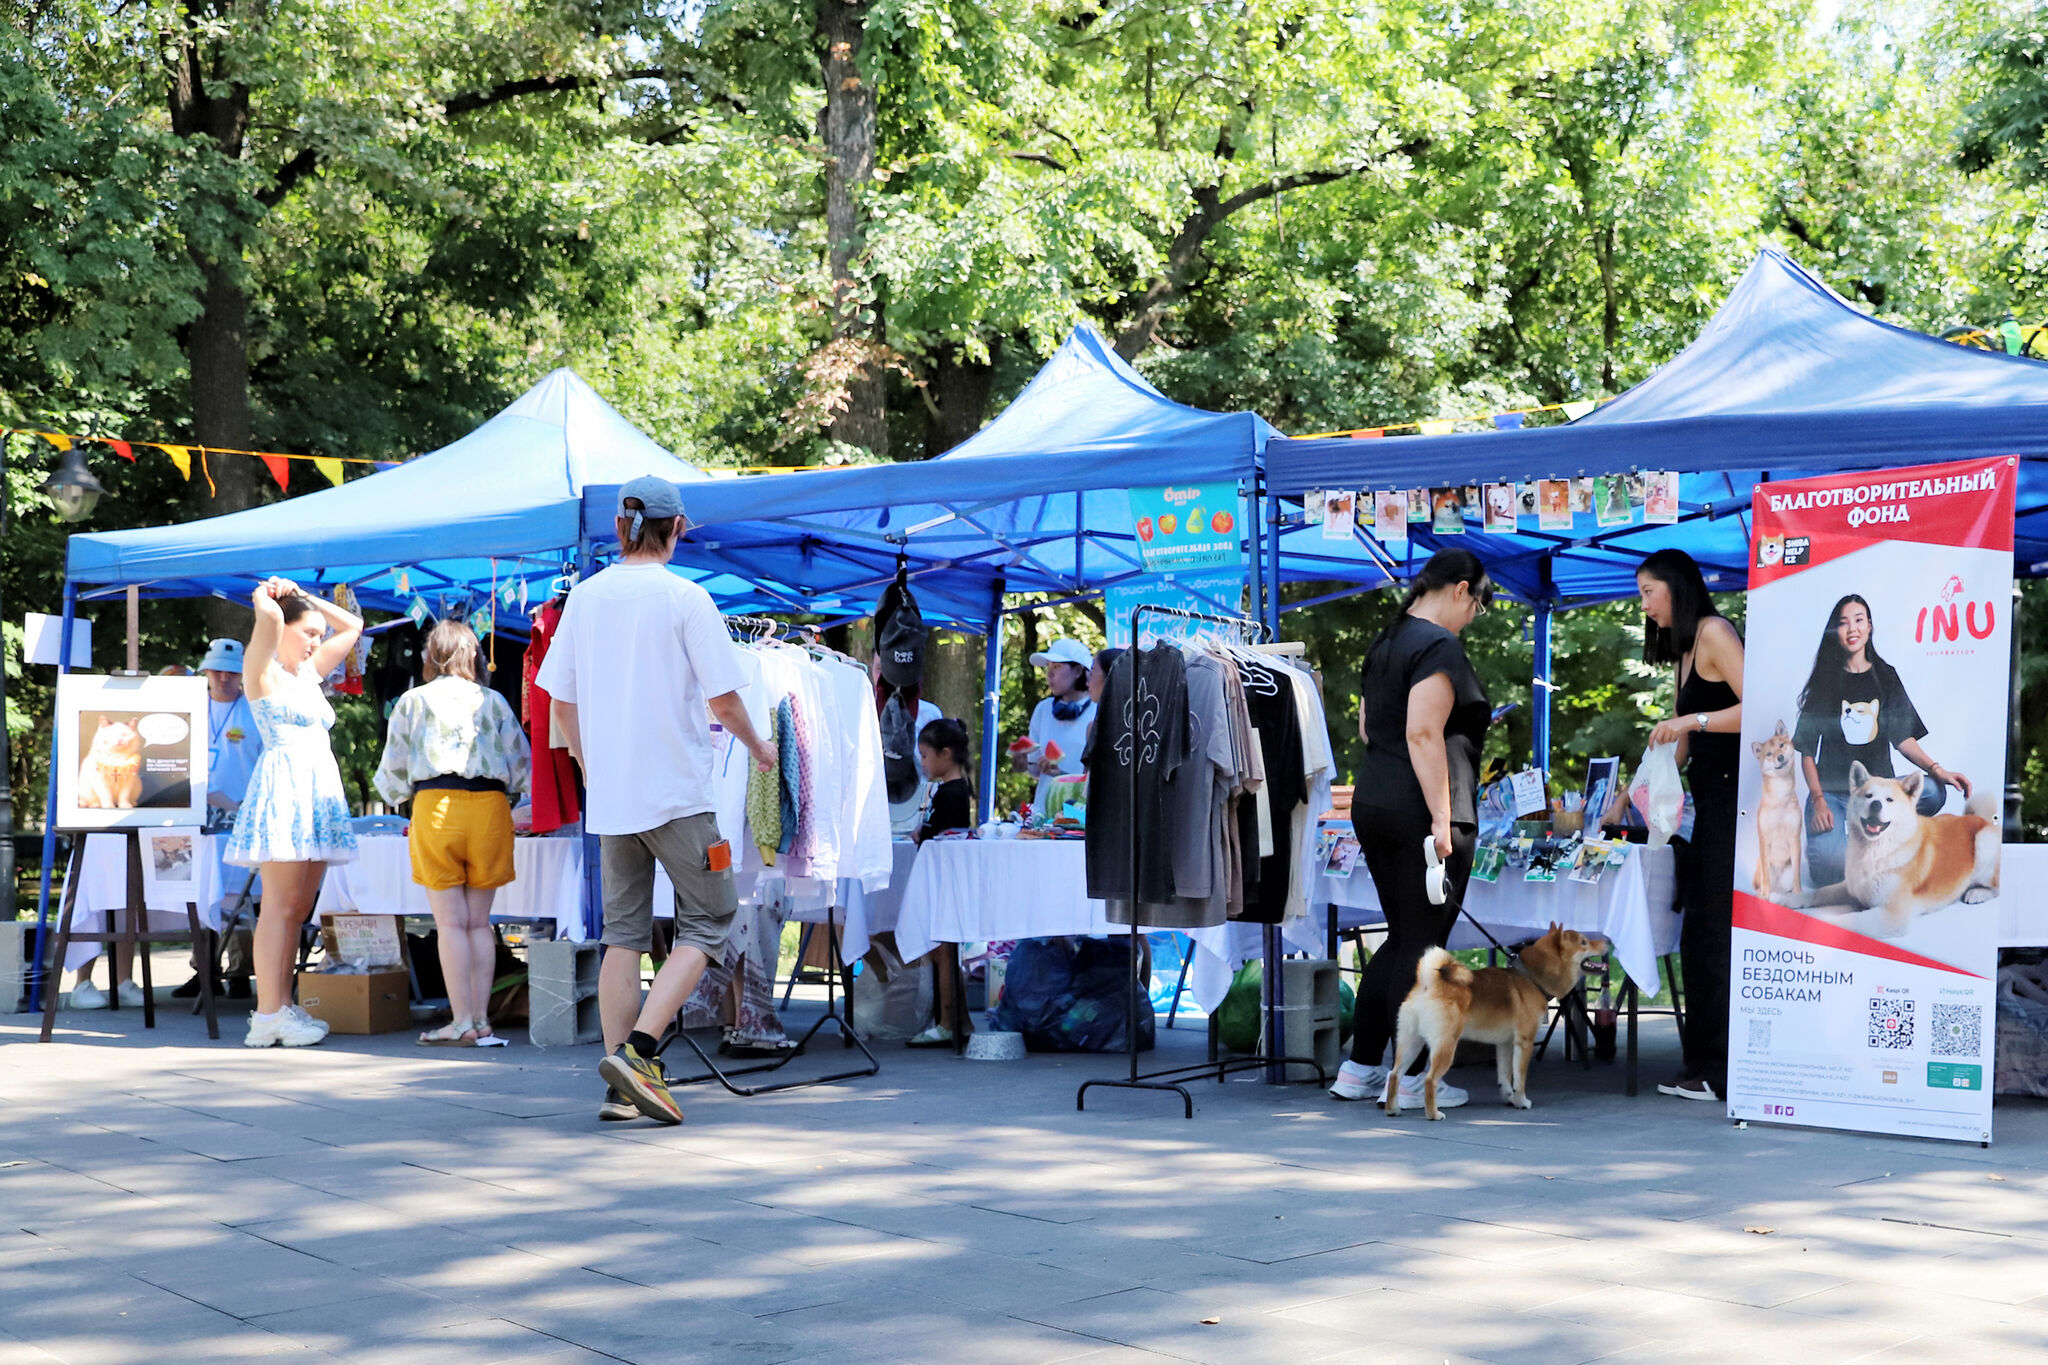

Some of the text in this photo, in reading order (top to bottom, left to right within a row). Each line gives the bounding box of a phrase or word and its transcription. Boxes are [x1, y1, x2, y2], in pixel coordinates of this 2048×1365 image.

[1770, 468, 1996, 512] БЛАГОТВОРИТЕЛЬНЫЙ
[1847, 504, 1910, 528] ФОНД
[1785, 538, 1809, 548] SHIBA
[1785, 547, 1804, 556] HELP
[1784, 556, 1797, 564] KZ
[1915, 600, 1995, 643] INU
[1743, 949, 1815, 964] ПОМОЧЬ
[1742, 967, 1853, 985] БЕЗДОМНЫМ
[1741, 986, 1821, 1002] СОБАКАМ
[1740, 1006, 1783, 1016] МЫ ЗДЕСЬ
